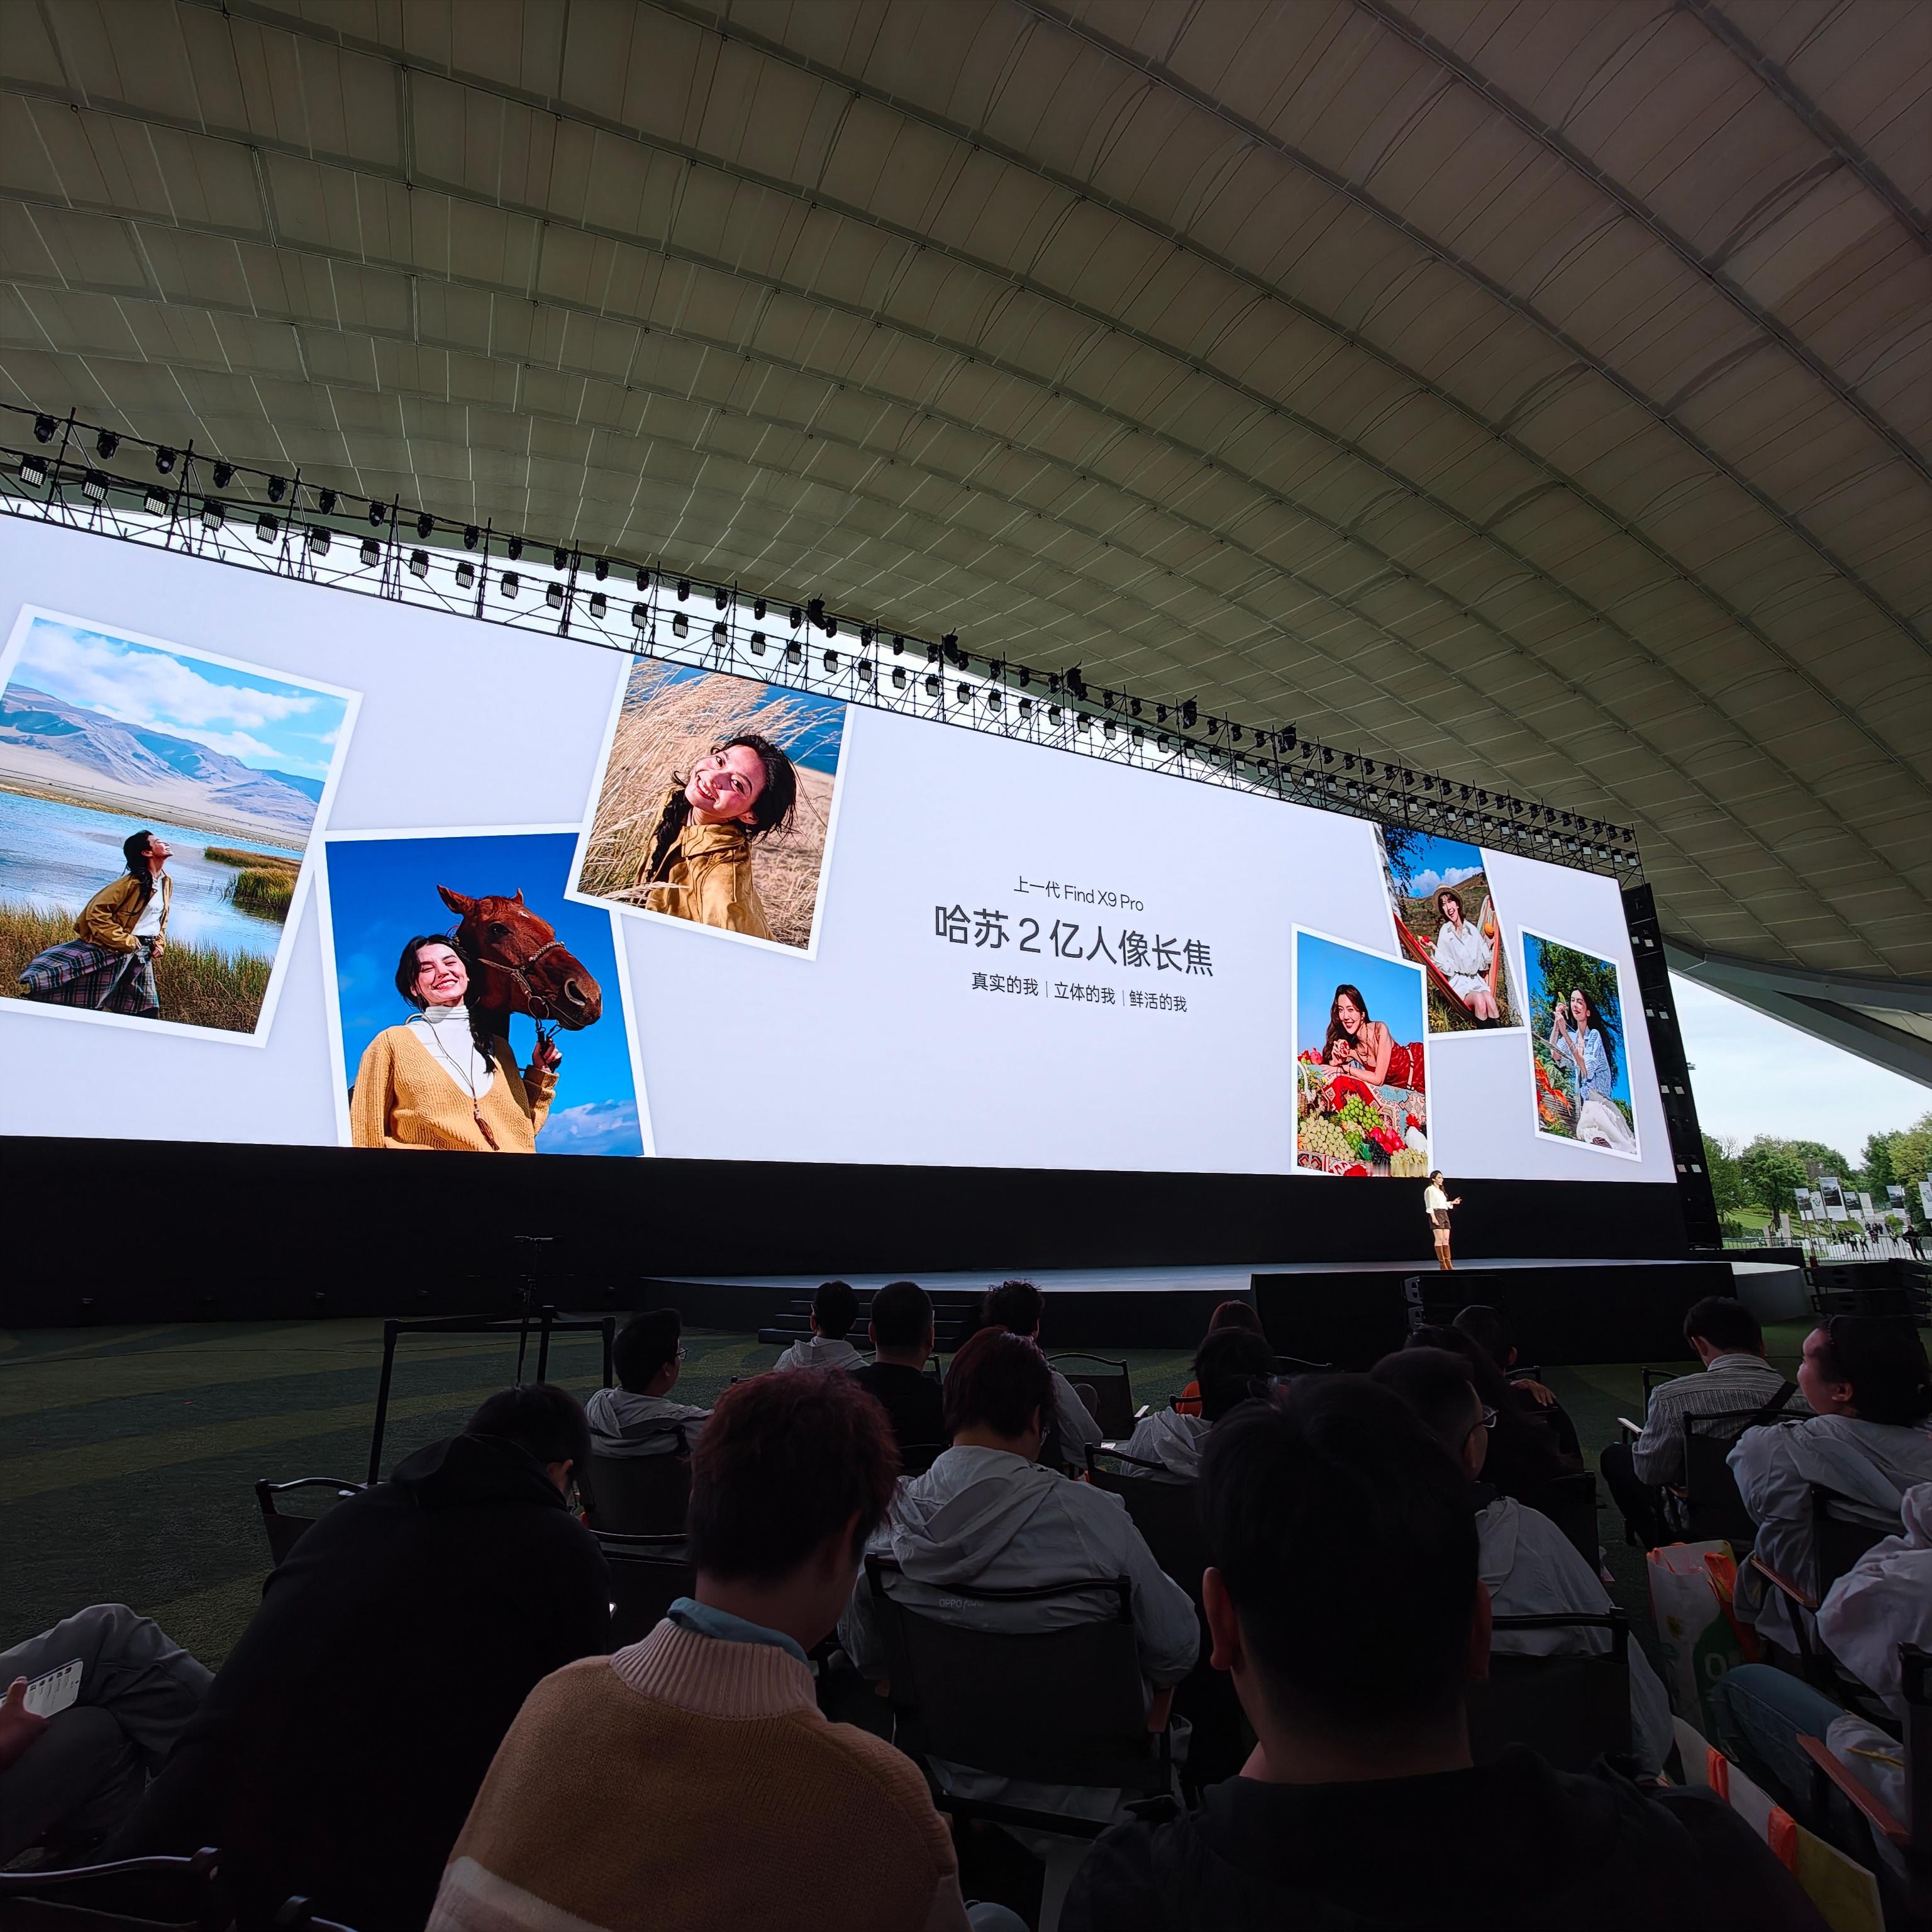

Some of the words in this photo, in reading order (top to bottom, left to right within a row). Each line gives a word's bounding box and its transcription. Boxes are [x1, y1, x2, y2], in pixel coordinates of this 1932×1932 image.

[1014, 875, 1060, 898] 上一代
[1064, 884, 1095, 904] Find
[1097, 890, 1117, 907] X9
[1120, 894, 1144, 911] Pro
[972, 972, 1039, 996] 真实的我
[1054, 981, 1116, 1004] 立体的我
[1129, 989, 1187, 1013] 鲜活的我
